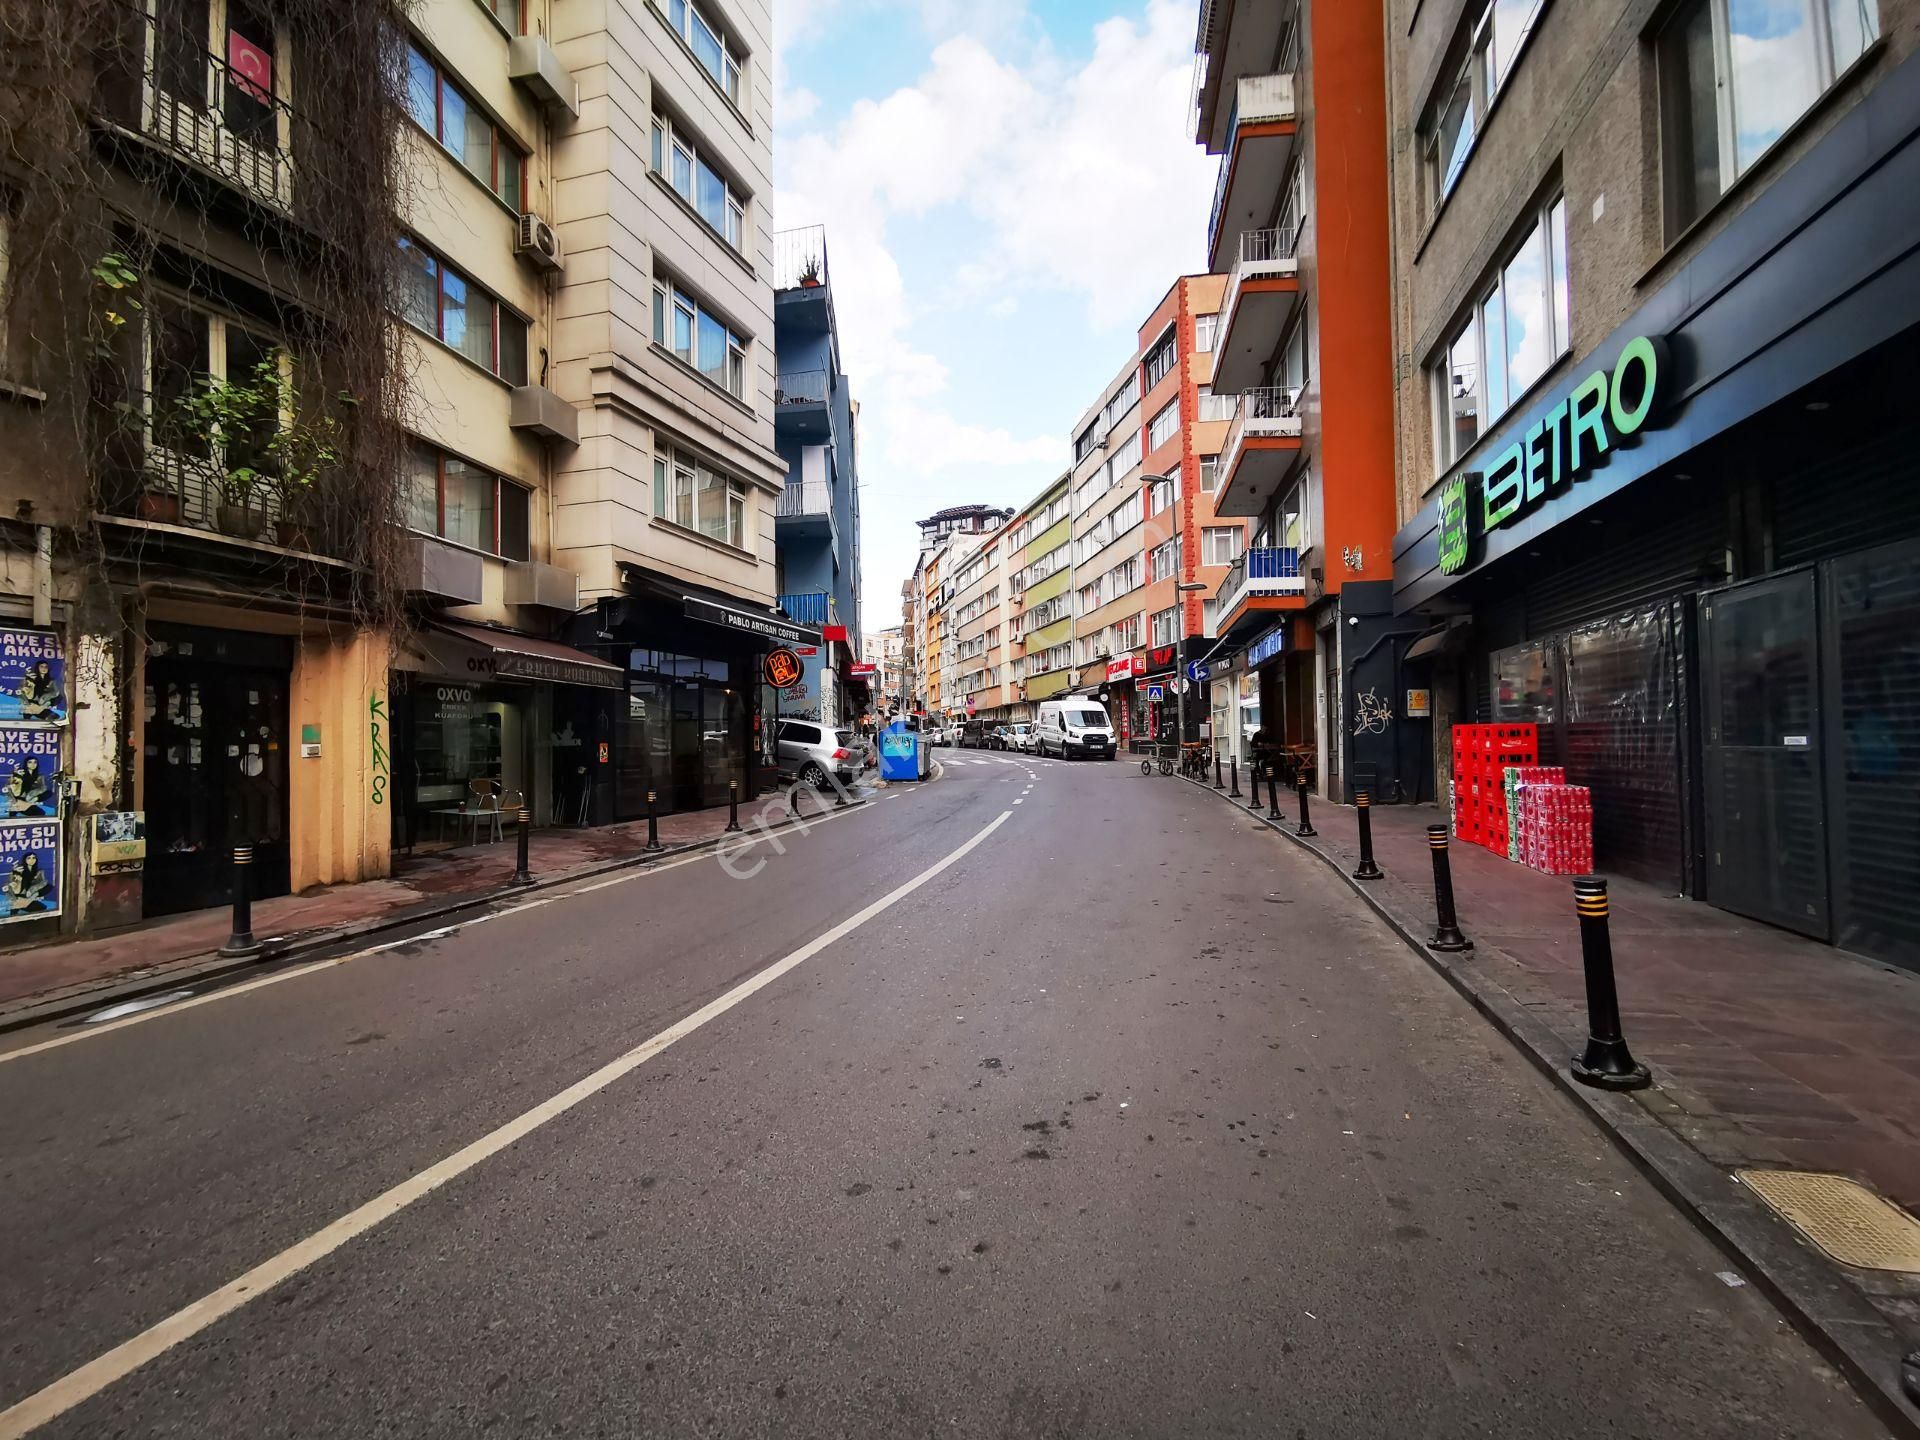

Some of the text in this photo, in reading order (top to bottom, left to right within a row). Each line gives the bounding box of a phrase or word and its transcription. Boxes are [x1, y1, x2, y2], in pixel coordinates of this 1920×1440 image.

[1483, 335, 1657, 531] BETRO
[728, 614, 750, 628] PABLO
[778, 628, 800, 641] COFFEE
[0, 633, 39, 647] AYE
[437, 687, 471, 702] OXVO
[34, 732, 58, 743] SU
[32, 826, 55, 838] SU
